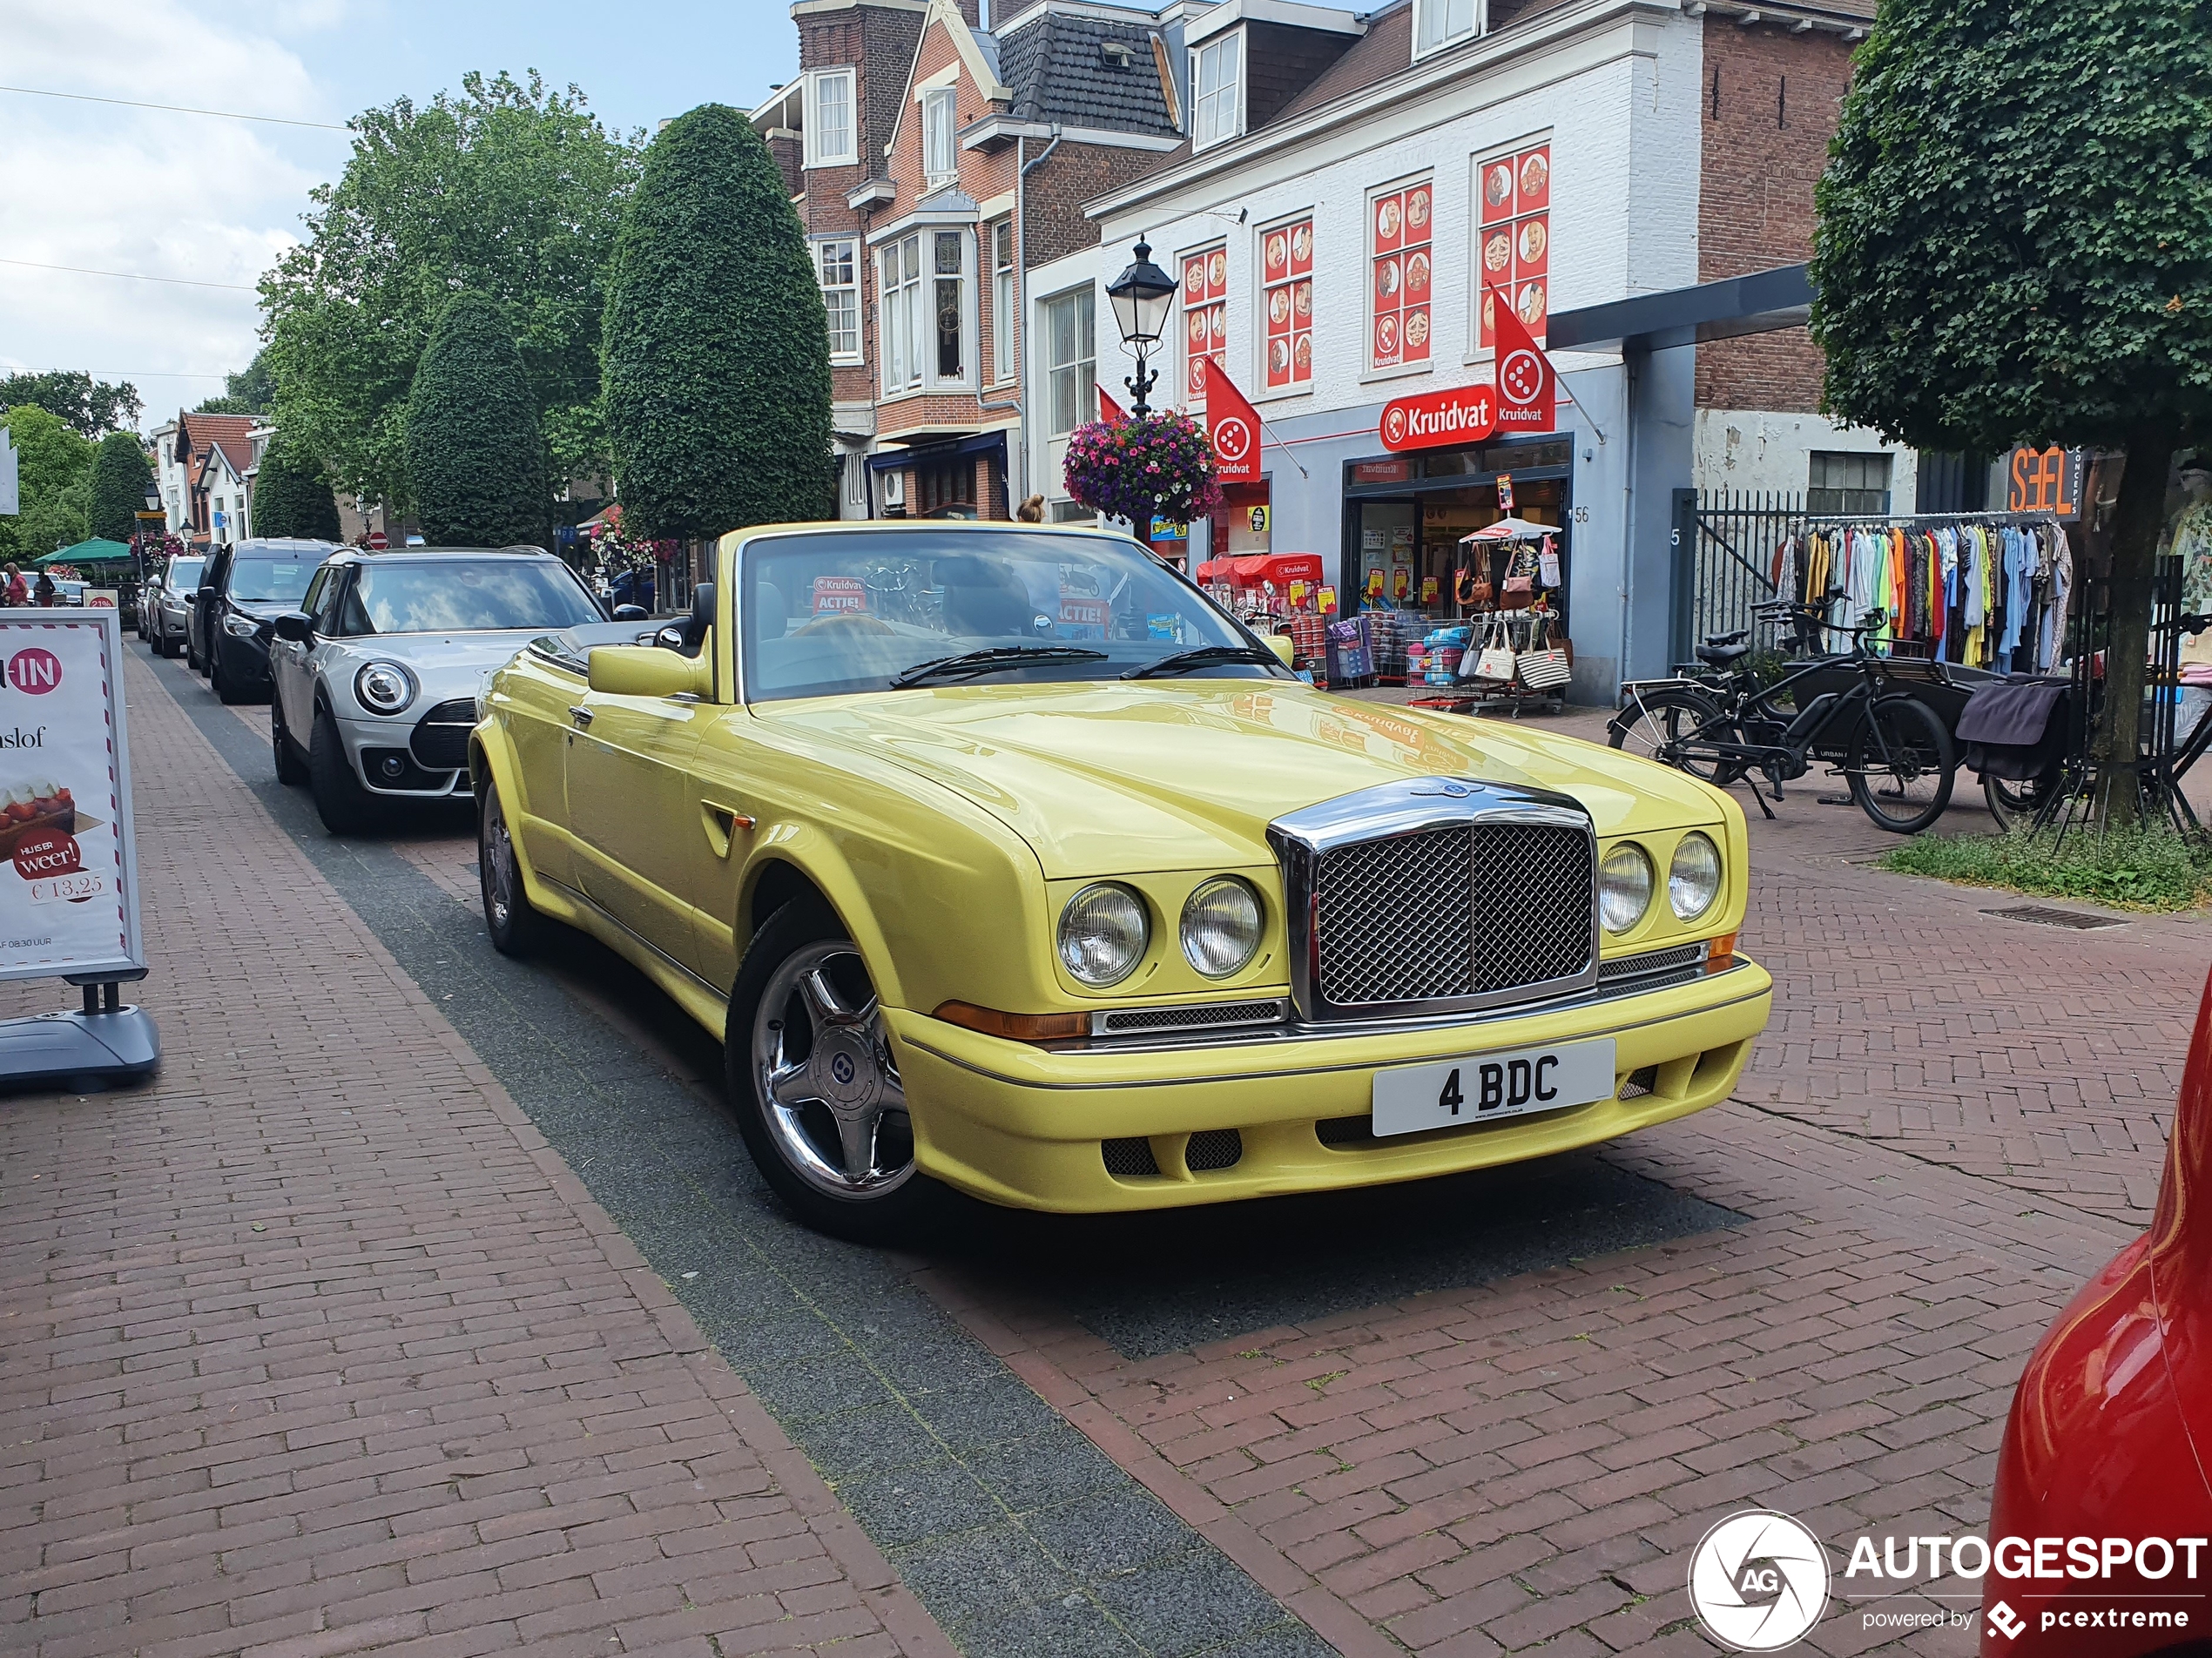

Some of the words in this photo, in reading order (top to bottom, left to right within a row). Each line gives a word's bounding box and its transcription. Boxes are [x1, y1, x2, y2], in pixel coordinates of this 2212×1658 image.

[1374, 354, 1399, 367] Kruidvat
[1409, 399, 1488, 435] Kruidvat
[1499, 408, 1541, 421] Kruidvat
[2072, 446, 2081, 514] CONCEPTS
[1575, 506, 1589, 522] 56
[1671, 528, 1680, 546] 5
[1285, 564, 1309, 574] Kruidvat
[819, 596, 859, 609] ACTIE!
[34, 844, 43, 853] IS
[42, 841, 53, 851] ER
[19, 841, 78, 873] weer!
[31, 883, 44, 900] €
[52, 876, 102, 898] 13,25
[33, 937, 51, 947] UUR
[1440, 1068, 1463, 1115] 4
[1479, 1055, 1559, 1111] BDC
